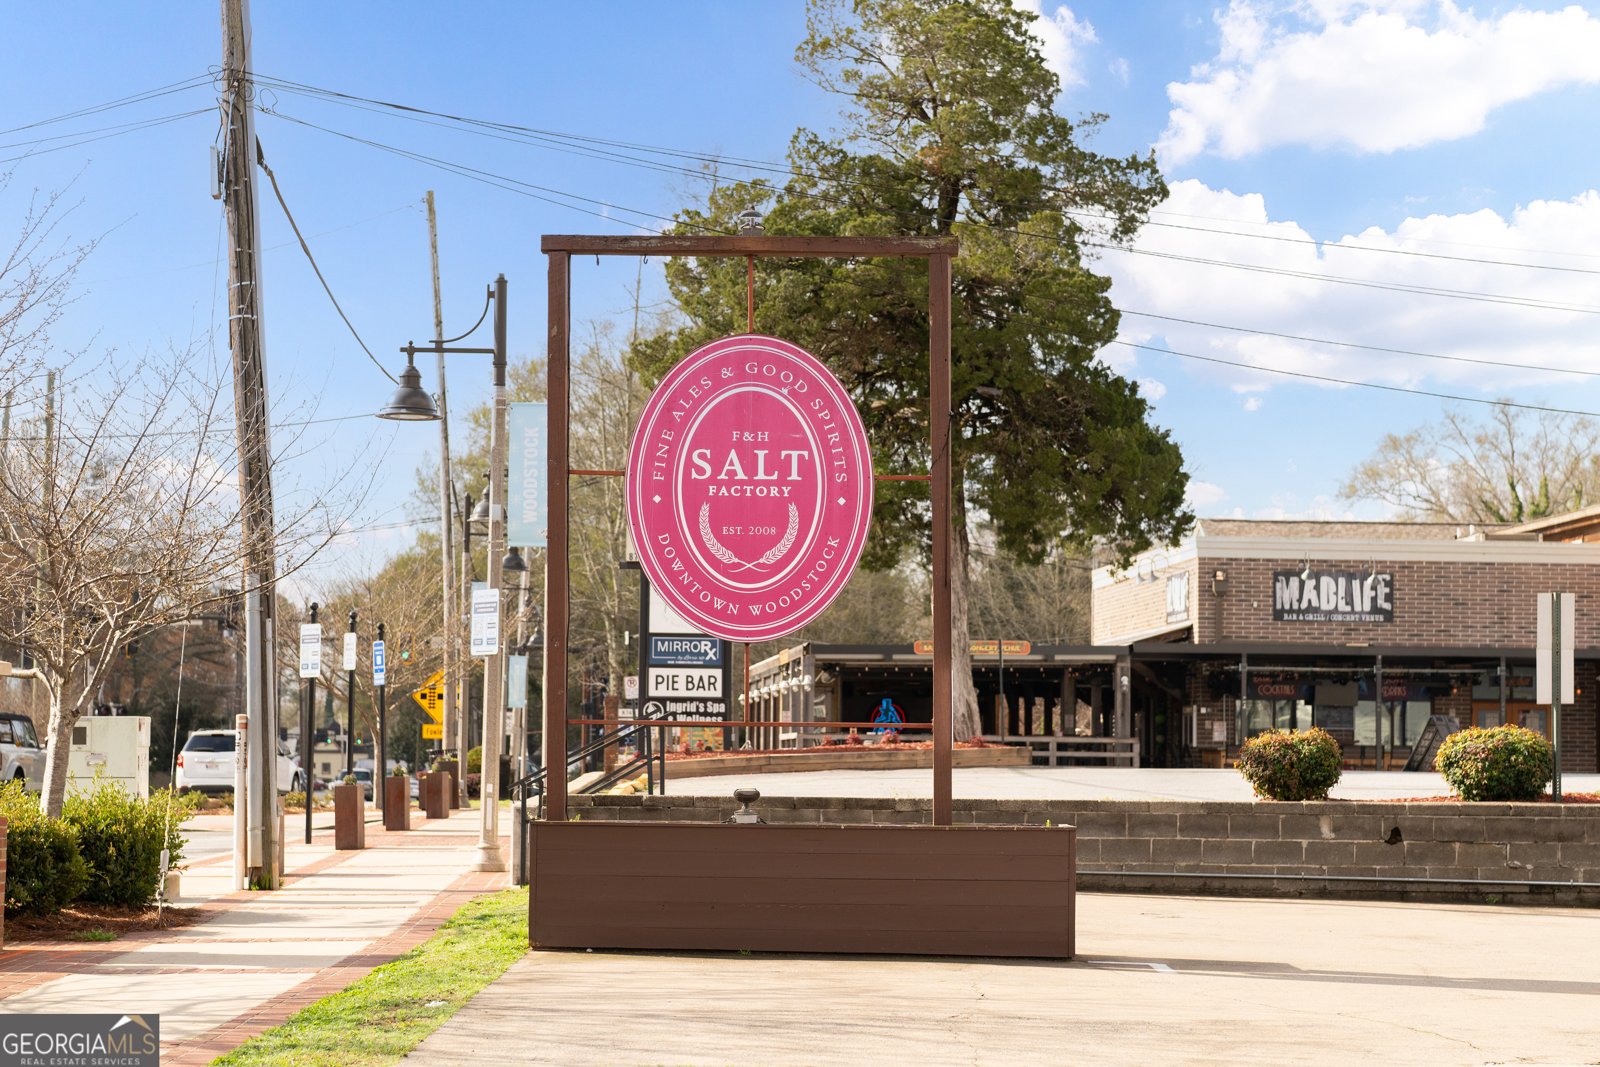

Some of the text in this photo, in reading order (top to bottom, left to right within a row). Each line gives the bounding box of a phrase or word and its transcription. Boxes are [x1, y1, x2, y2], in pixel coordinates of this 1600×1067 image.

[653, 362, 848, 483] FINE ALES & GOOD SPIRITS
[522, 427, 539, 523] WOODSTOCK
[691, 448, 809, 480] SALT
[708, 485, 792, 497] FACTORY
[722, 526, 776, 536] EST. 2008
[657, 533, 840, 616] DOWNTOWN WOODSTOCK
[1275, 574, 1392, 612] MADLIFE
[1304, 613, 1325, 621] GRILL
[1361, 614, 1384, 622] VENUE
[655, 675, 717, 691] PIE BAR
[666, 701, 726, 714] Ingrid's Spa
